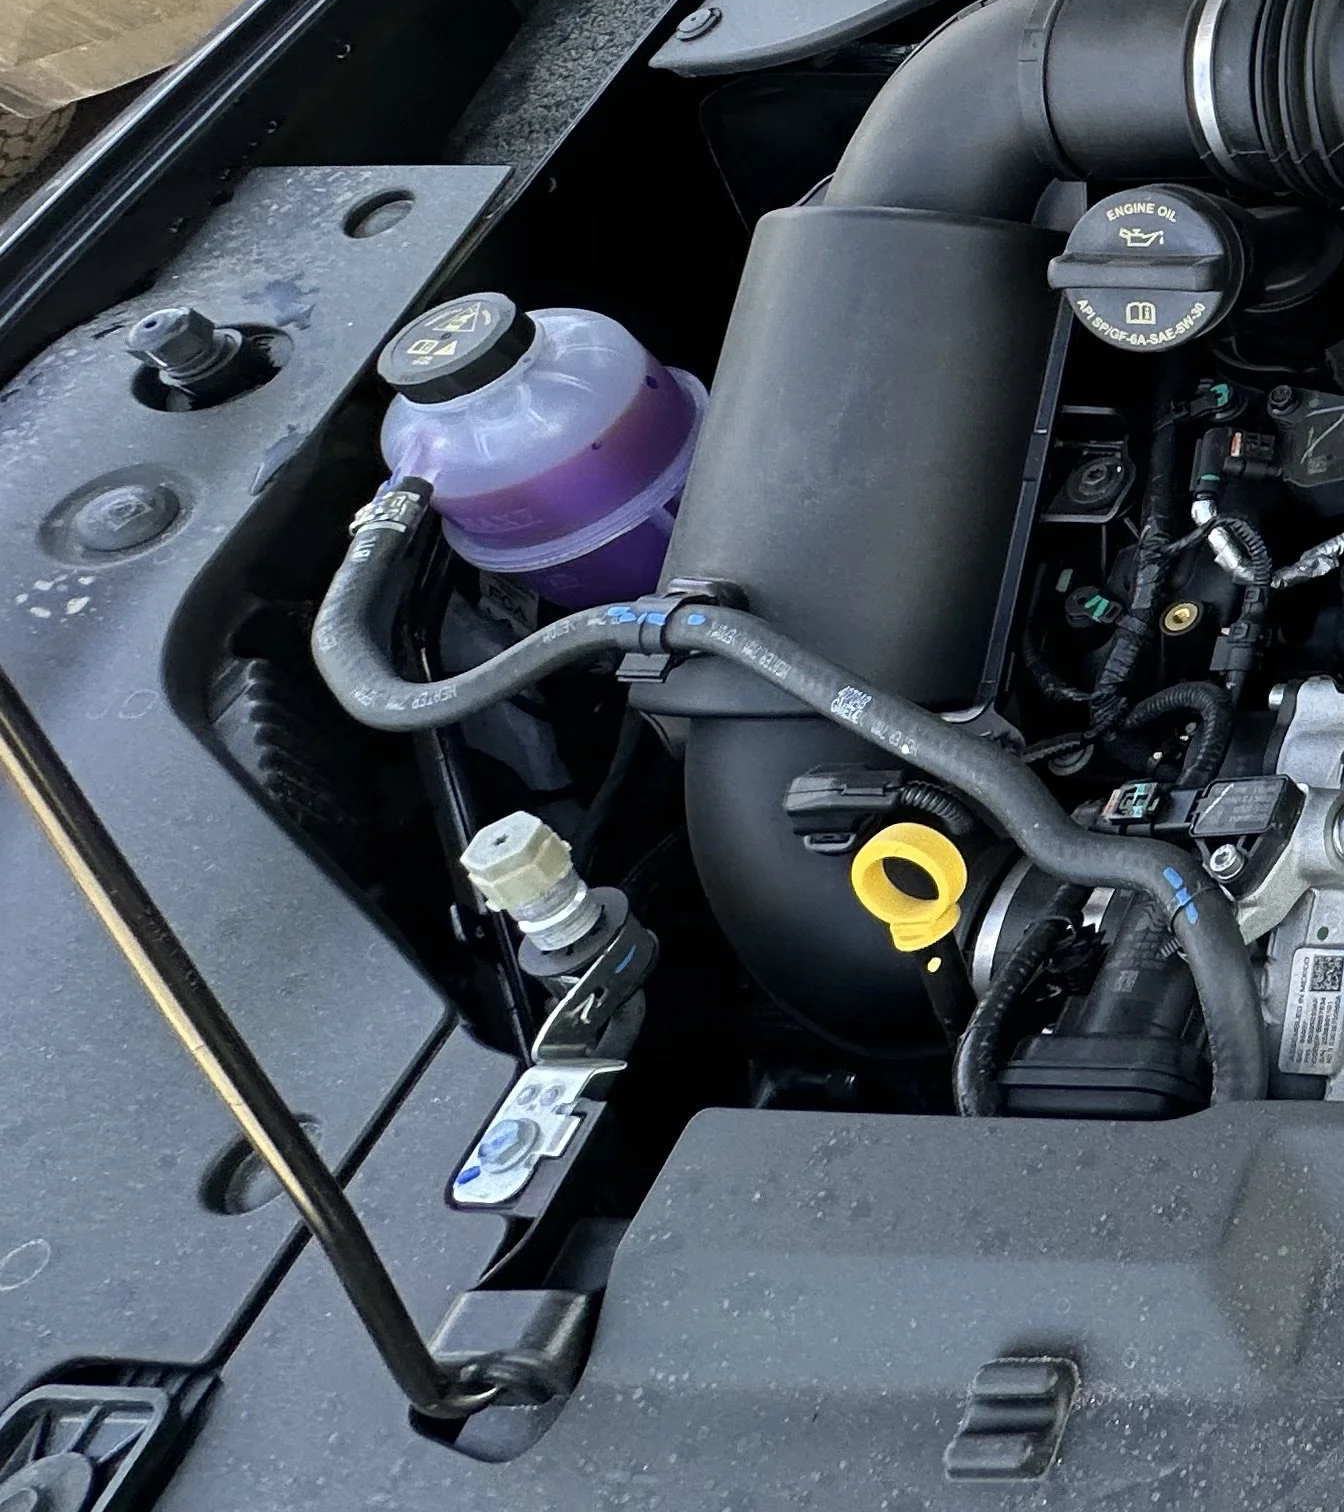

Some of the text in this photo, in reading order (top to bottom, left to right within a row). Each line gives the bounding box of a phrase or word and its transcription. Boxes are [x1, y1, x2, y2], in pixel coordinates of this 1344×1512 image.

[1106, 202, 1177, 223] ENGINE OIL
[1077, 299, 1096, 320] API
